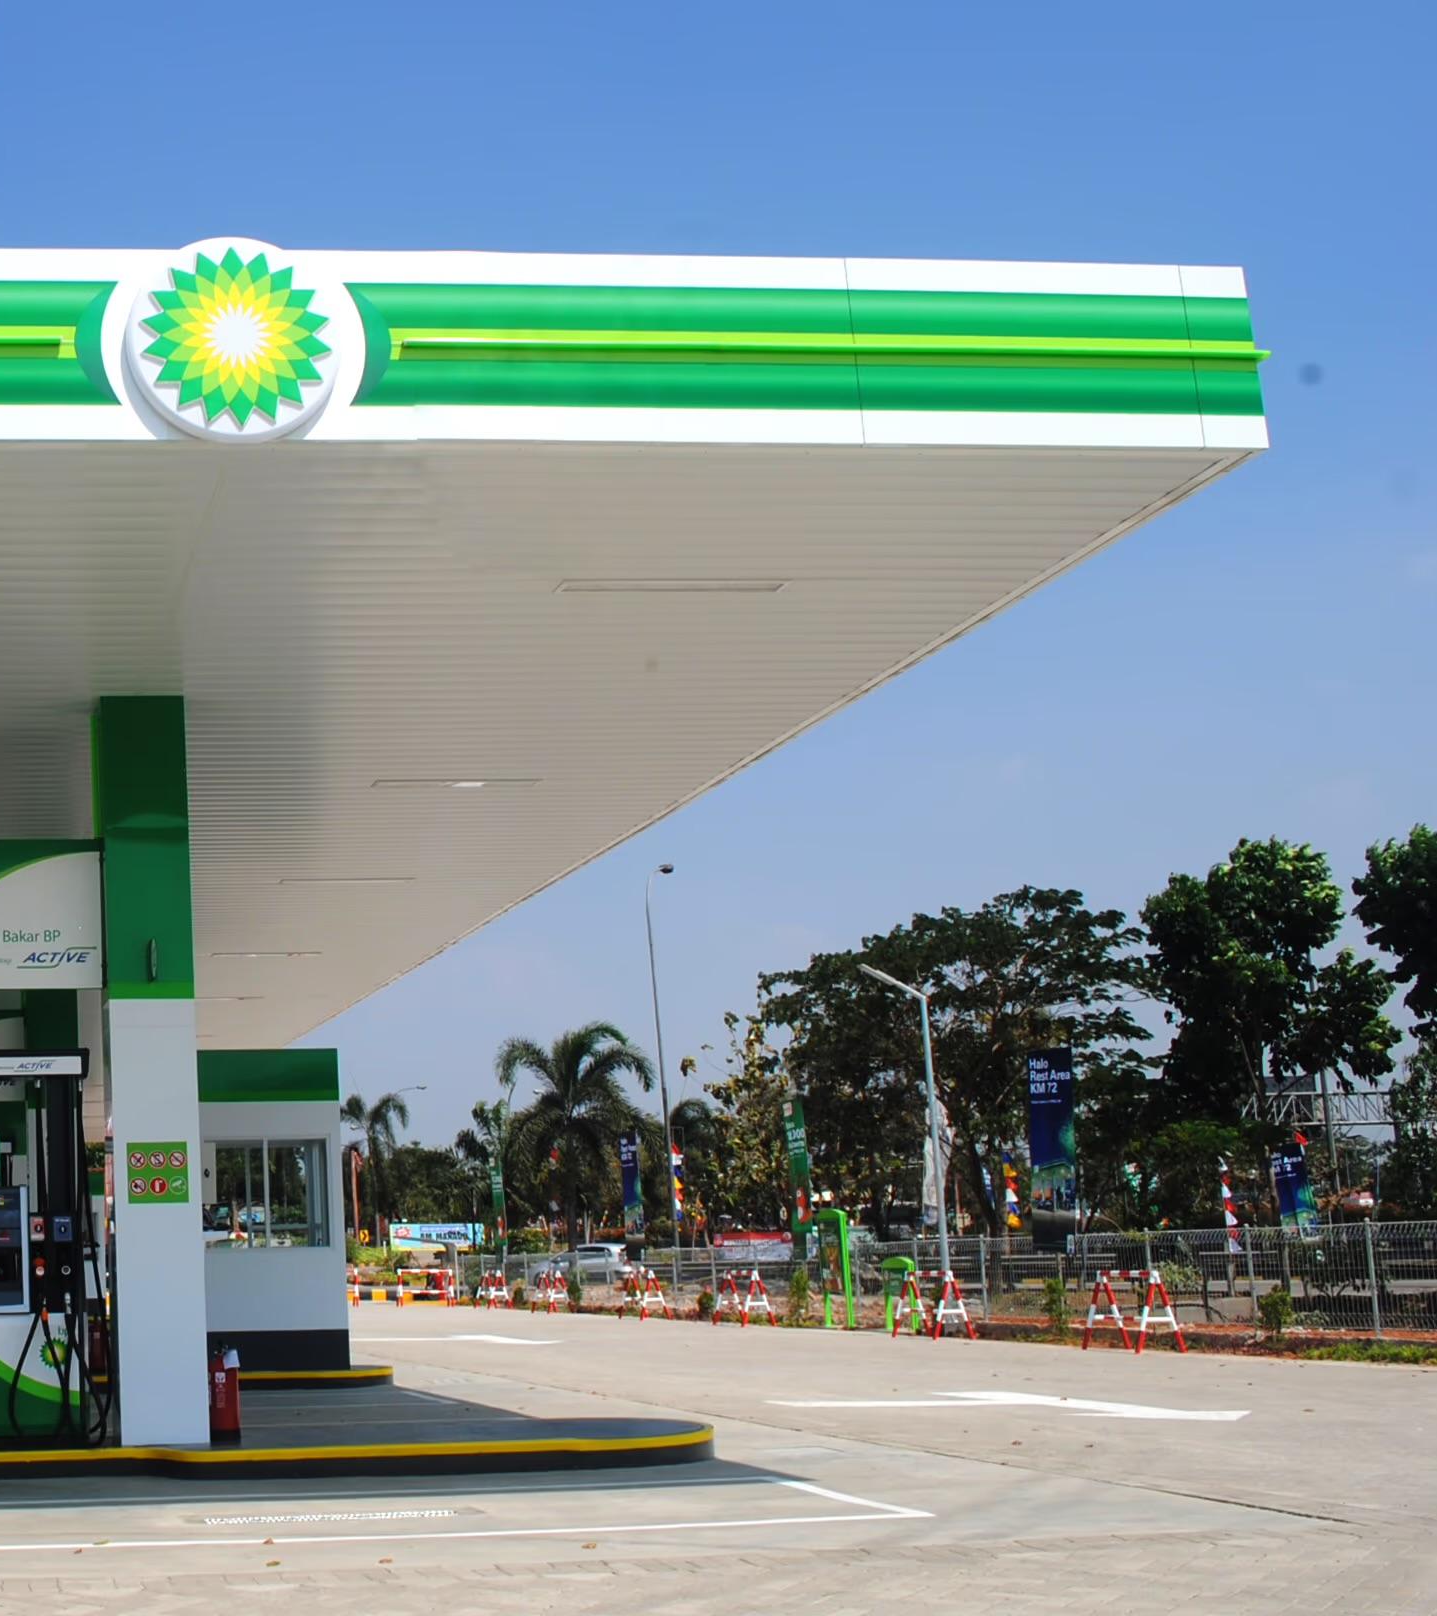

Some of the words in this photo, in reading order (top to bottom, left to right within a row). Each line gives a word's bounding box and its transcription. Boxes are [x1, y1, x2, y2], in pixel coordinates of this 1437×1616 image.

[3, 930, 40, 943] Bakar
[44, 930, 61, 943] BP
[22, 950, 91, 965] ACTIVE
[16, 1061, 54, 1071] ACTIVE
[1029, 1058, 1049, 1069] Halo
[1030, 1070, 1048, 1081] Rest
[1050, 1070, 1071, 1080] Area
[1030, 1082, 1046, 1094] KM
[1047, 1082, 1058, 1093] 72
